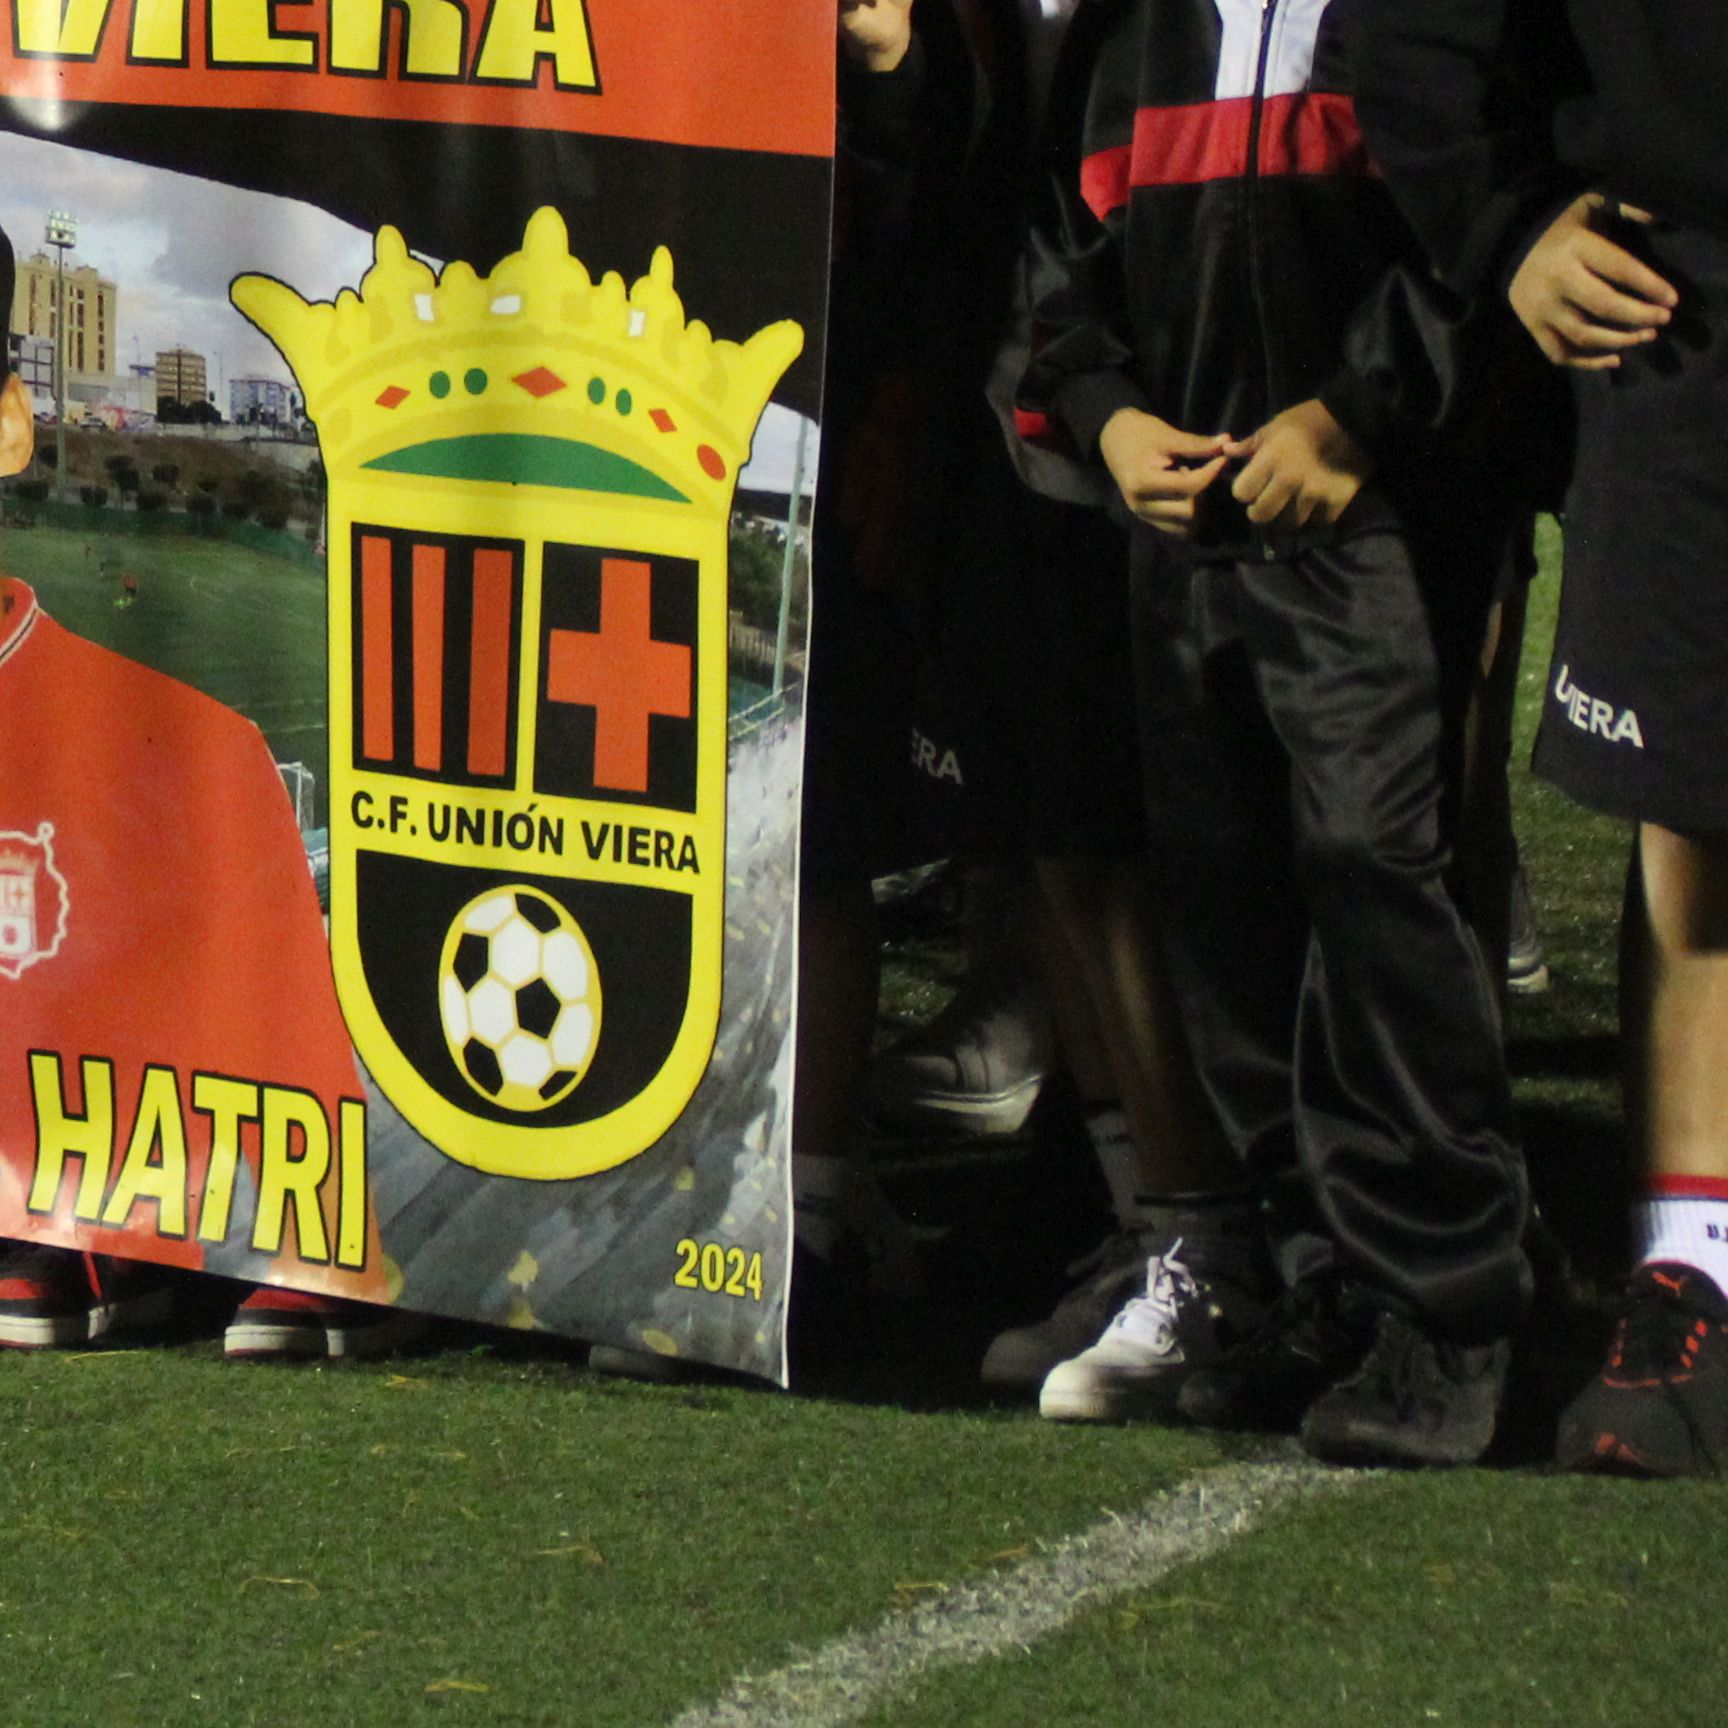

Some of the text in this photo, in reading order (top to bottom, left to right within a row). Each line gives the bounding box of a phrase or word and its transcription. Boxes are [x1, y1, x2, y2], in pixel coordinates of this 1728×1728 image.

[350, 791, 700, 875] C.F. UNIÓN VIERA
[28, 1049, 368, 1270] HATRI
[673, 1238, 763, 1301] 2024
